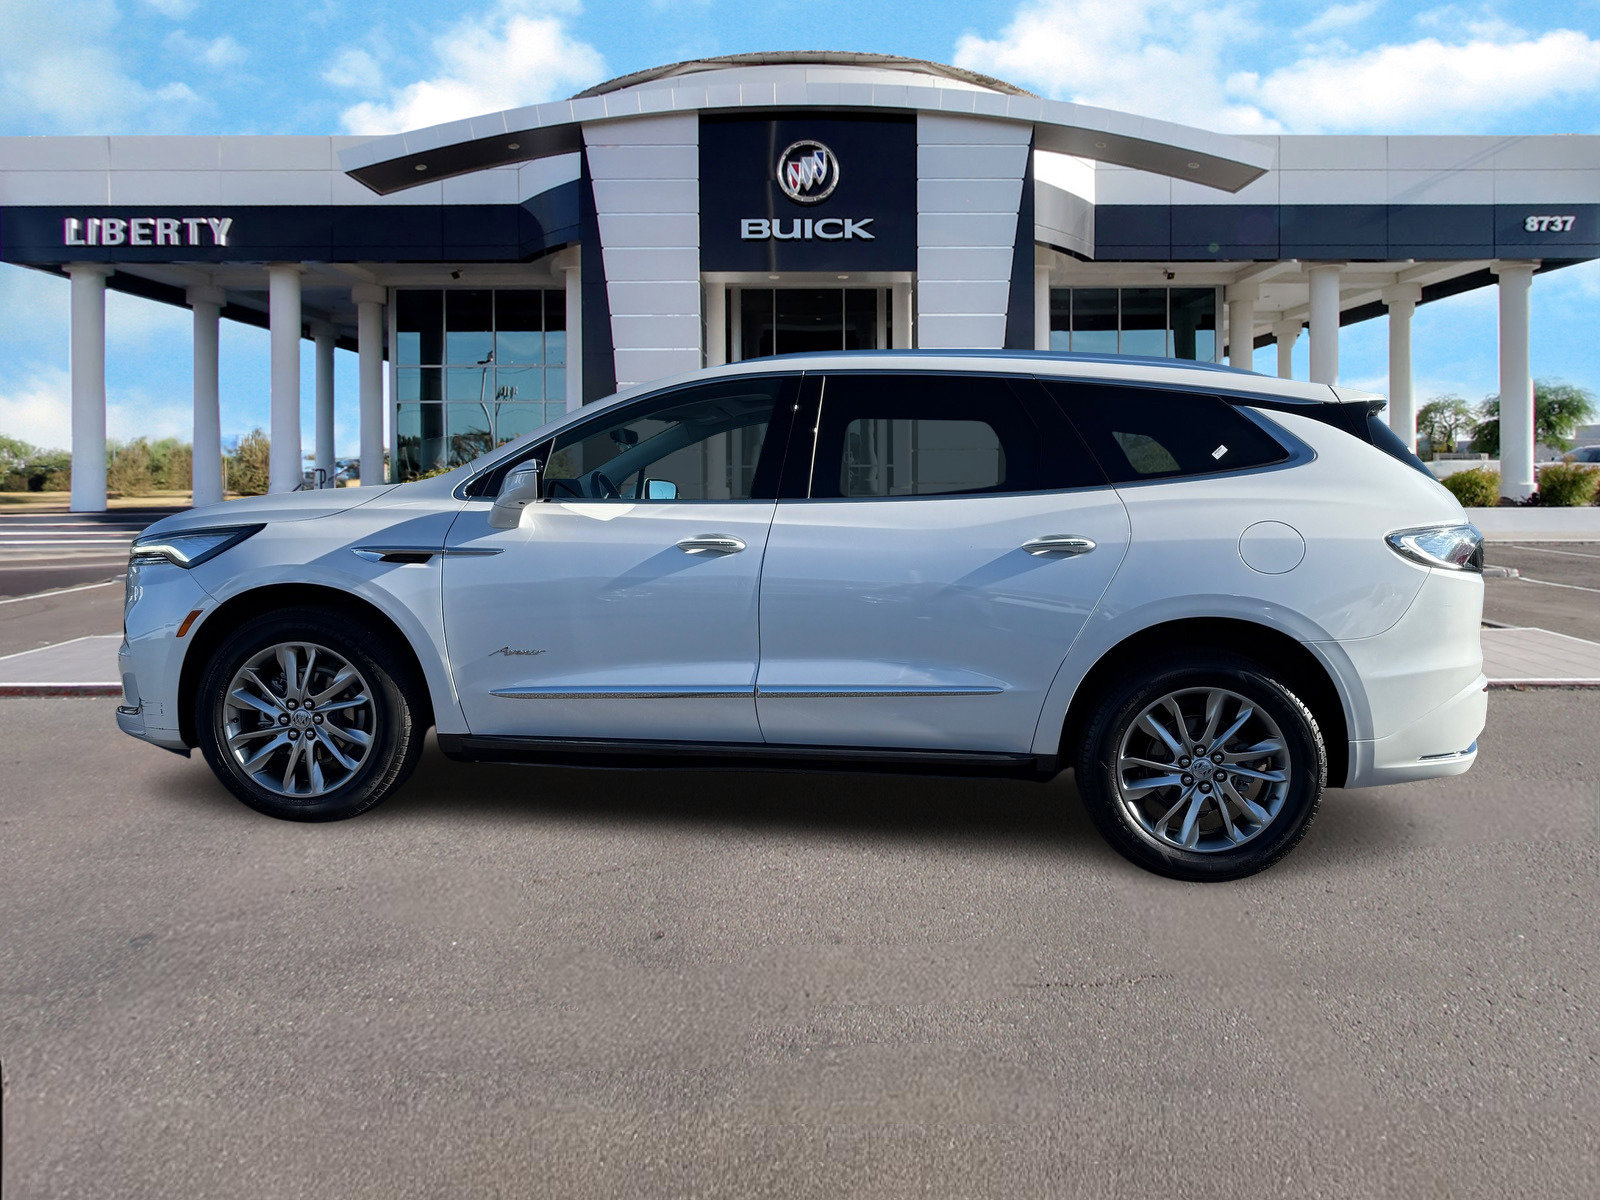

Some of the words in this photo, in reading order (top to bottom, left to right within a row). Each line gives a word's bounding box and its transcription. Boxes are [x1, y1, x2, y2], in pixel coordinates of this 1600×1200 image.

[64, 217, 233, 246] LIBERTY
[741, 218, 875, 239] BUICK
[1525, 215, 1576, 231] 8737
